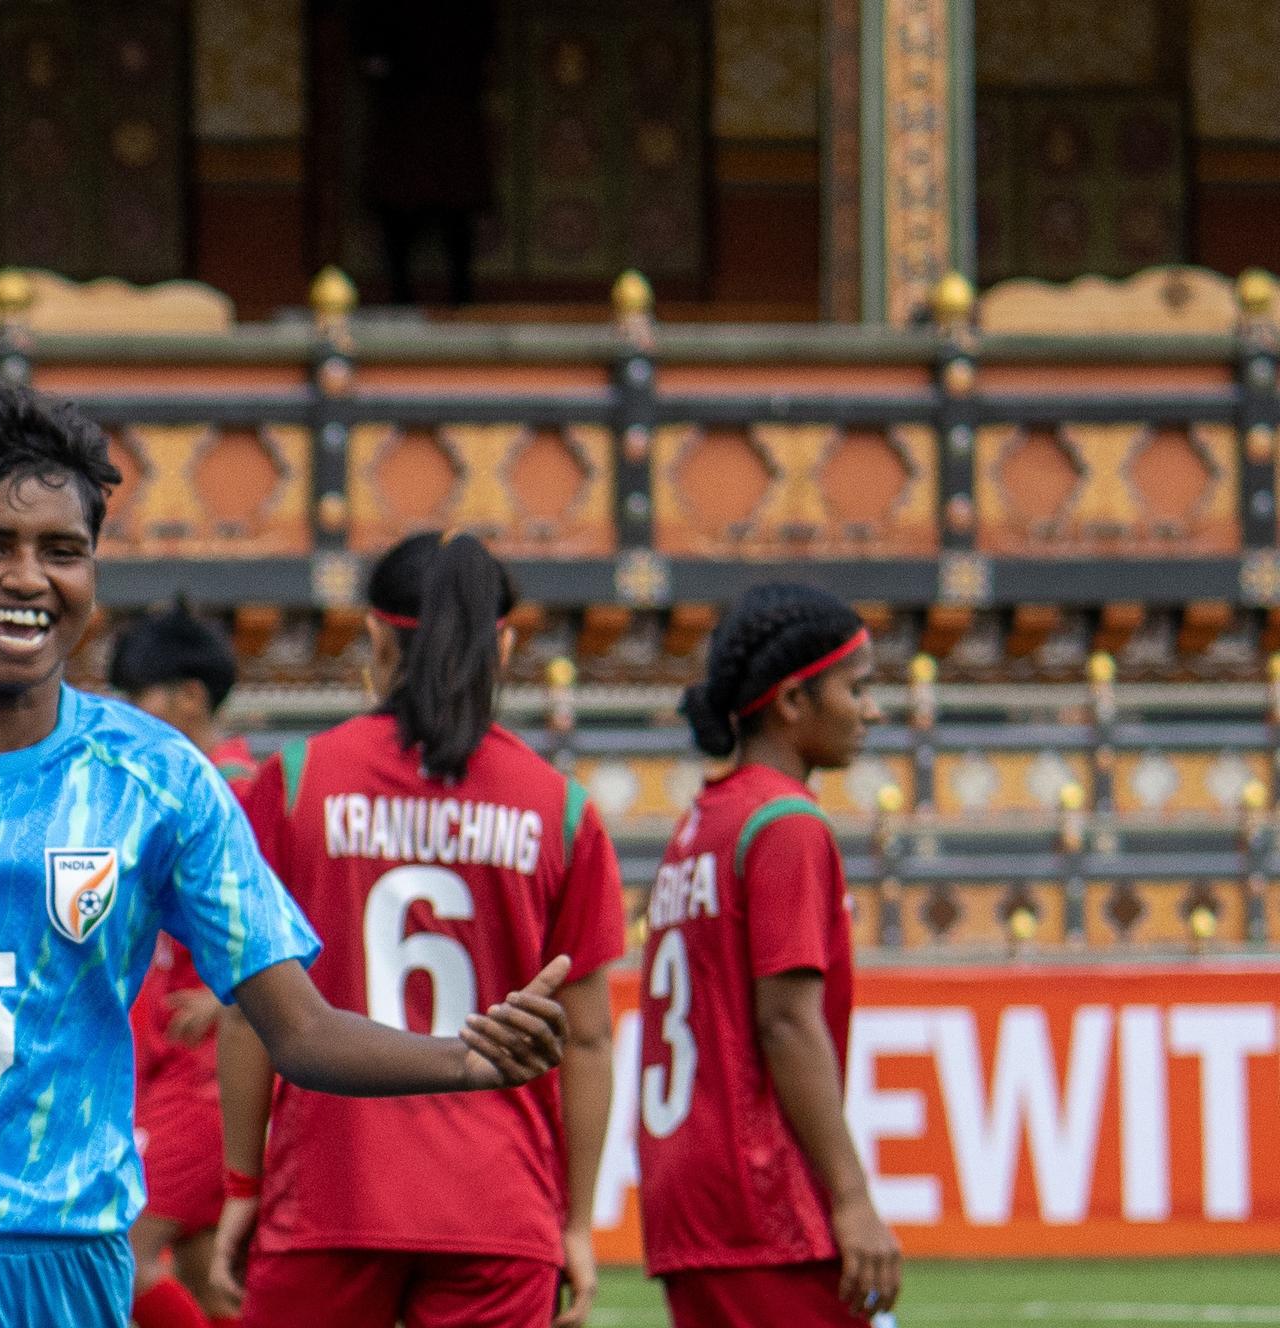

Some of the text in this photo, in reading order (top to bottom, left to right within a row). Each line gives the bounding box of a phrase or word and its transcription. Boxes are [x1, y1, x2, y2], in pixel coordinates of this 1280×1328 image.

[60, 860, 96, 871] INDIA
[324, 793, 543, 876] KRANUCHING
[363, 865, 477, 1038] 6
[643, 929, 698, 1138] 3
